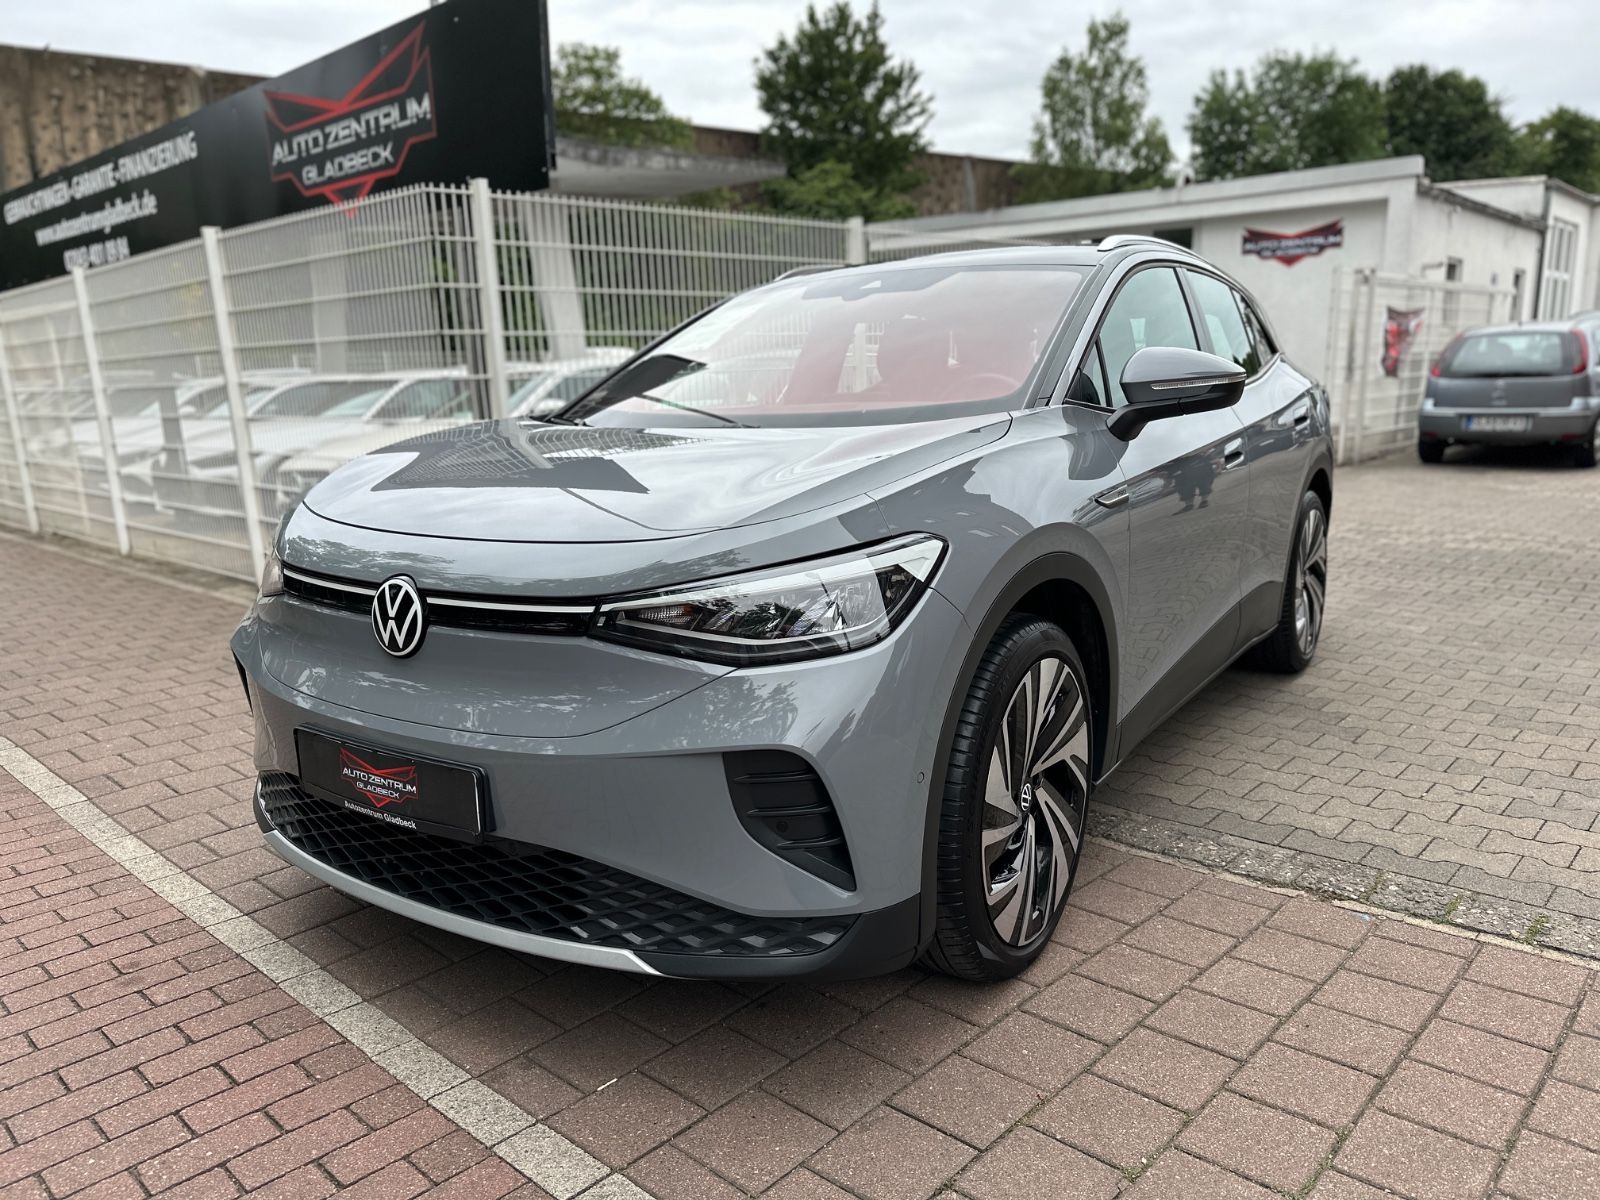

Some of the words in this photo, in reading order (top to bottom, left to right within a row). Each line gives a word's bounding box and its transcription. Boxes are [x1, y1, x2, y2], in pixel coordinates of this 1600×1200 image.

[272, 129, 324, 165] AUTO
[325, 92, 432, 150] ZENTRUM
[302, 141, 394, 185] GLADBECK
[342, 767, 368, 781] AUTO
[368, 774, 417, 794] ZENTRUM
[356, 781, 400, 799] GLADBECK
[383, 813, 417, 830] Gladbeck
